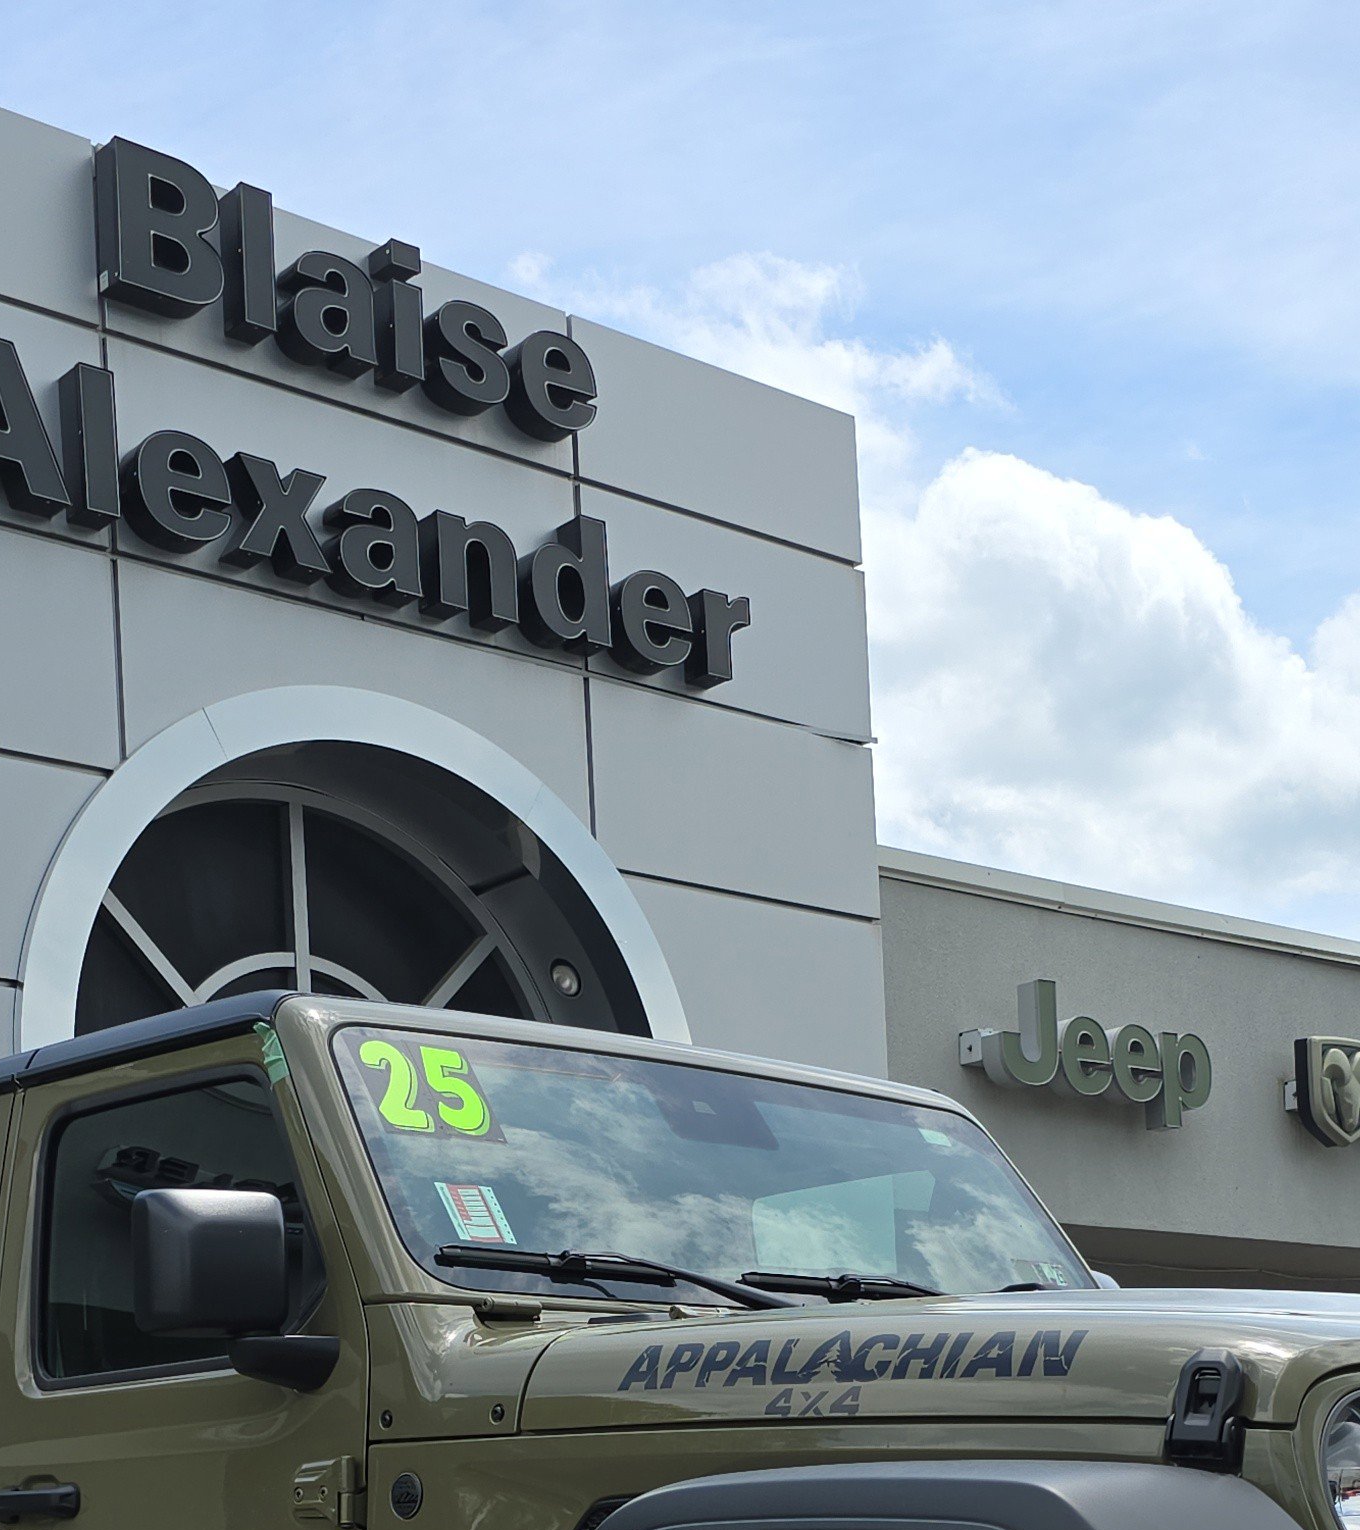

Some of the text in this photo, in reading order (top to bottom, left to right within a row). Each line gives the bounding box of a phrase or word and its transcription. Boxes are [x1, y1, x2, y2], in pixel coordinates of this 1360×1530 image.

[96, 135, 597, 441] Blaise
[358, 1040, 491, 1137] 25
[982, 978, 1212, 1130] Jeep
[617, 1329, 1089, 1391] APPALACHIAN
